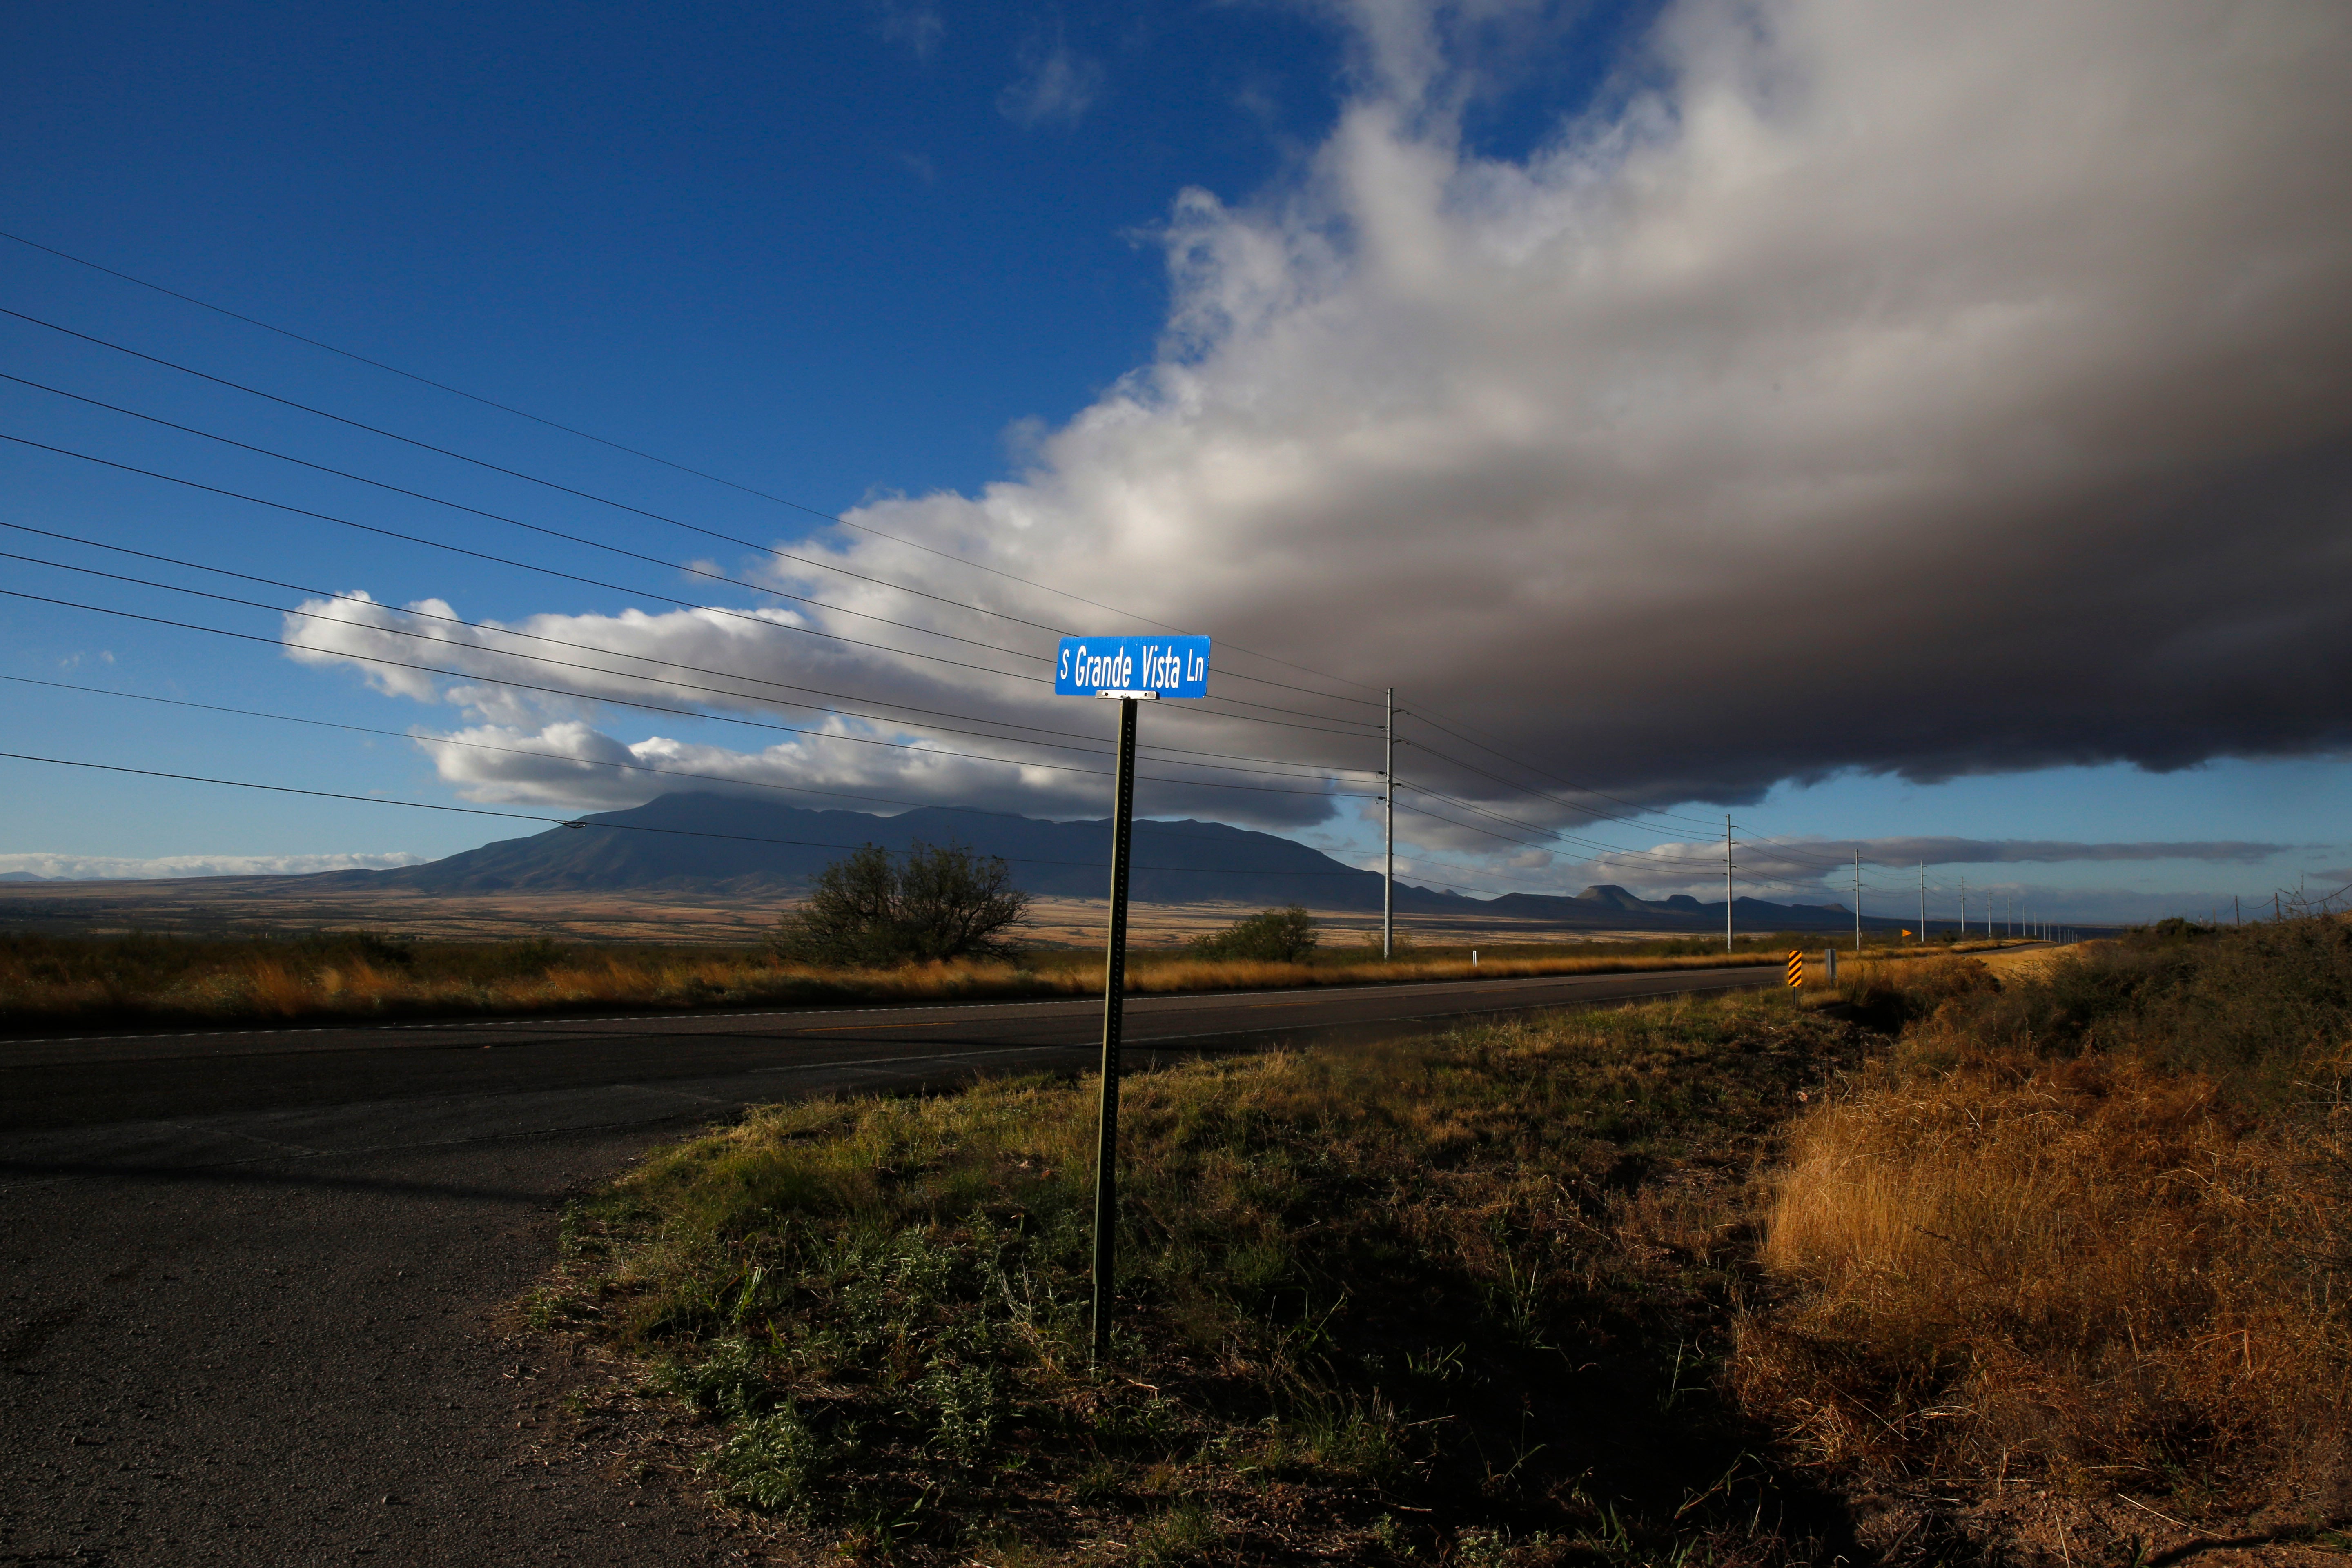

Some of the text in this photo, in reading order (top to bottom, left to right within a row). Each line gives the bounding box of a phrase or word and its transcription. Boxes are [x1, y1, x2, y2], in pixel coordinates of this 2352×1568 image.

[1060, 645, 1204, 688] S Grande Vista Ln
